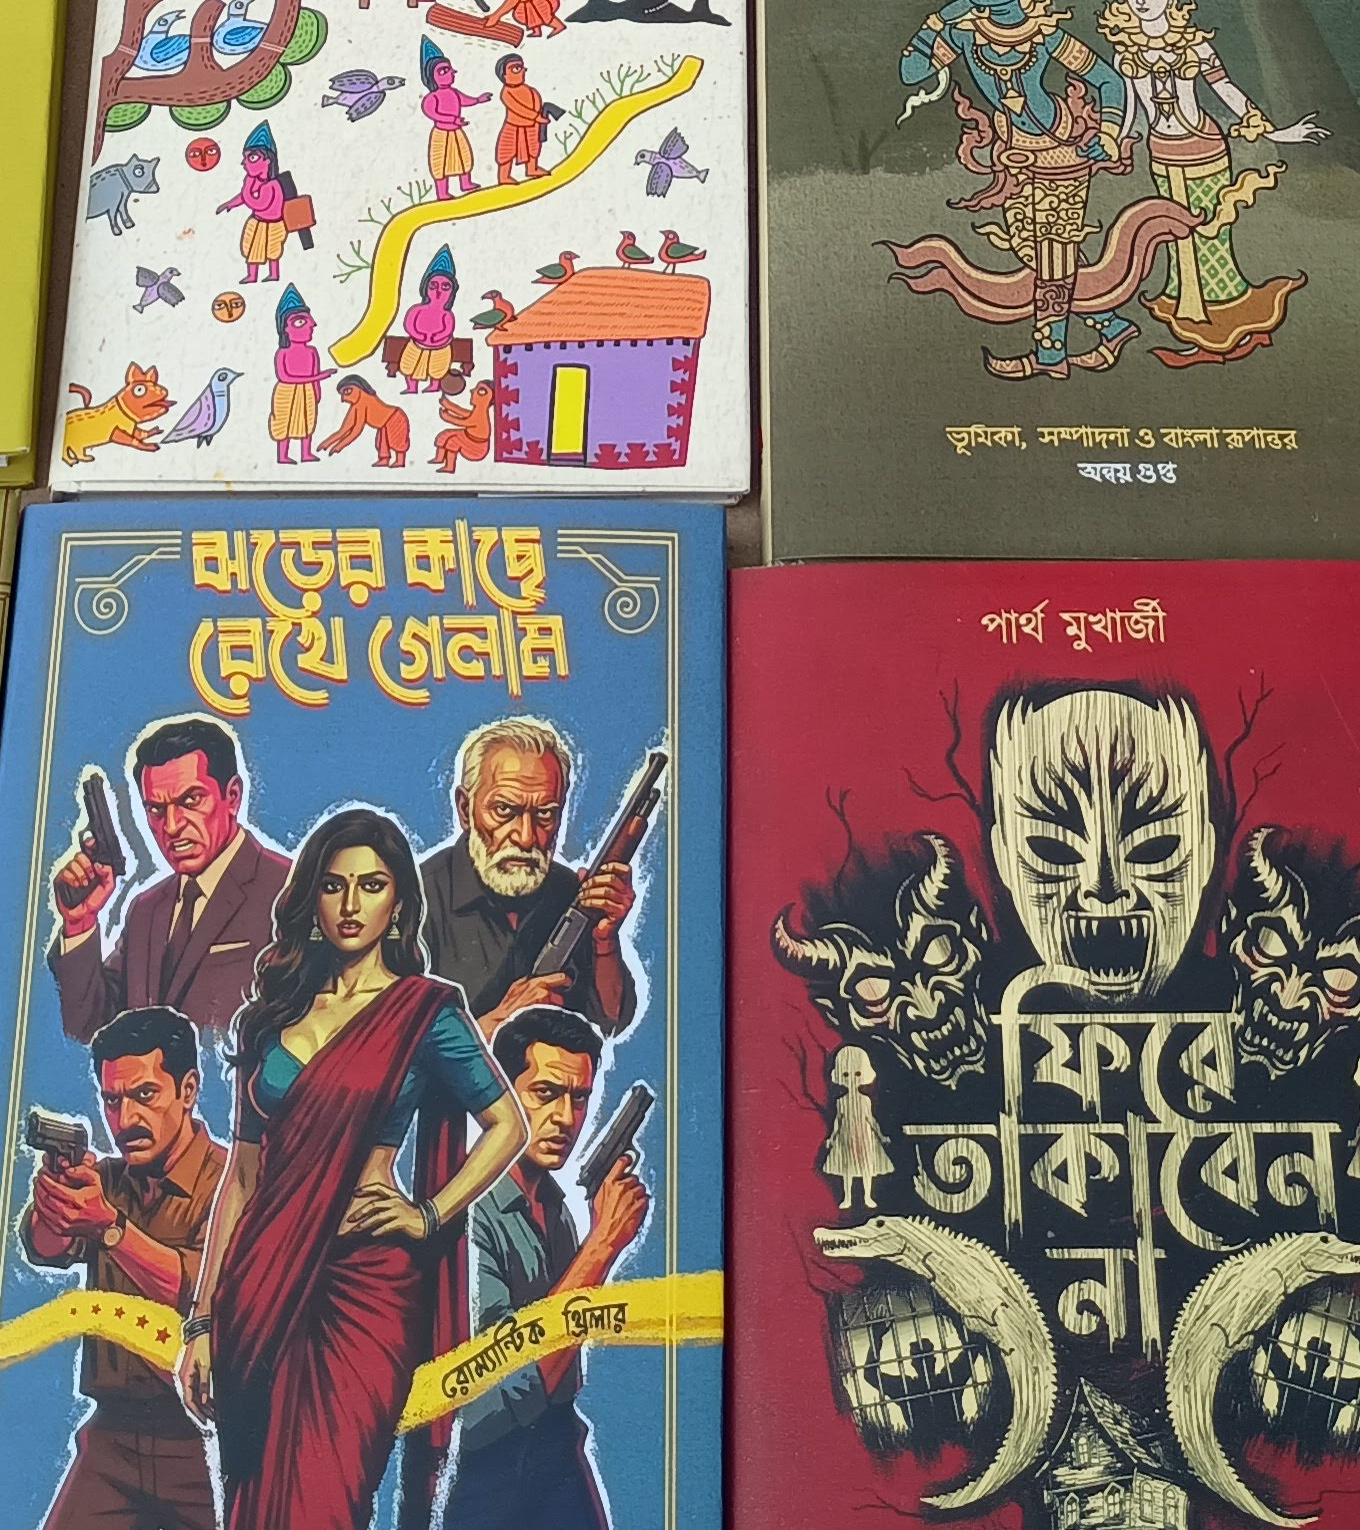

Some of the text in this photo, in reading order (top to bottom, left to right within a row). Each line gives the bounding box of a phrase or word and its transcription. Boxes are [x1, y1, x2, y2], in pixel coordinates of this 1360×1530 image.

[945, 424, 1299, 456] ভূমিকা, সম্পাদনা ও বাংলা রূপান্তর
[1077, 461, 1178, 485] অন্বয় গুপ্ত
[191, 518, 547, 620] ঝড়ের কাছে
[189, 610, 570, 717] রেখে গেলাম
[981, 598, 1167, 653] পার্থ মুখার্জী
[990, 964, 1244, 1122] ফিরে
[902, 1110, 1341, 1255] তাকাবেন
[442, 1296, 628, 1399] রোম্যান্টিক থ্রিলার
[1045, 1248, 1167, 1363] না
